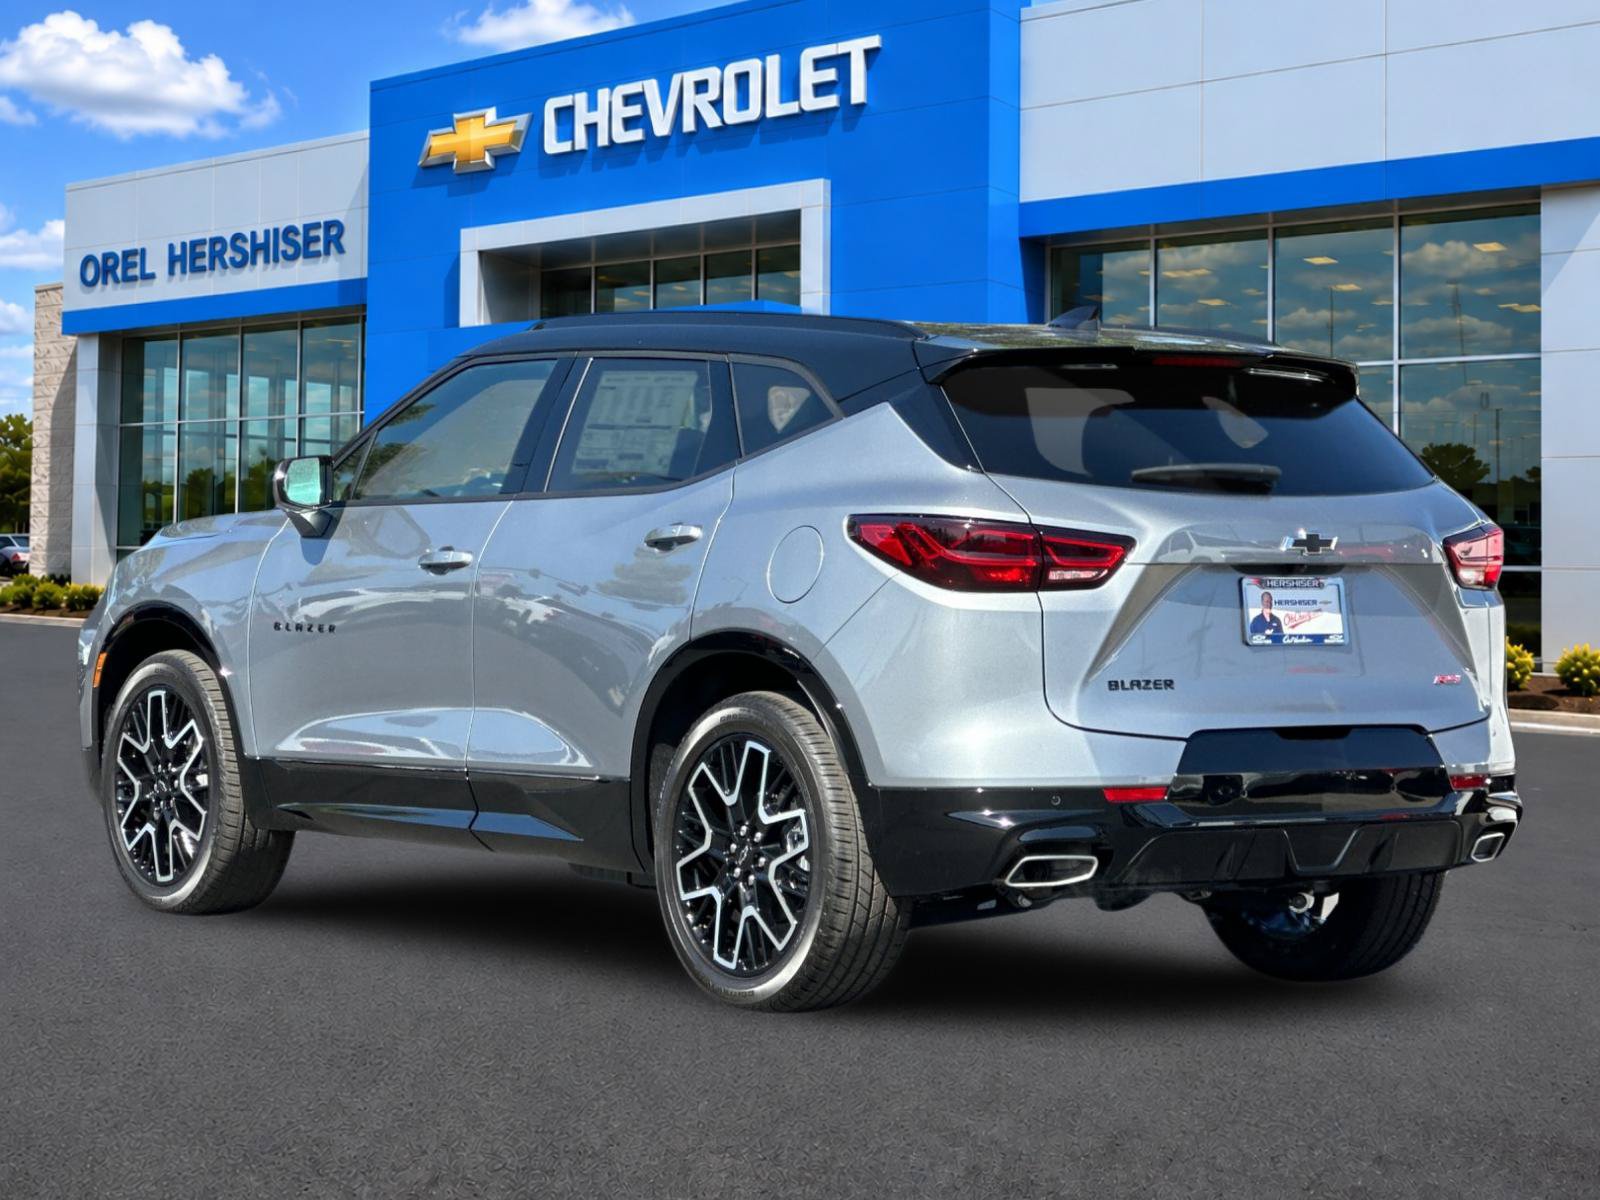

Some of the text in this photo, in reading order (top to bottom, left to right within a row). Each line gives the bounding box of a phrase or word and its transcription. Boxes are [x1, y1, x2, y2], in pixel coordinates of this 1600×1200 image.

[544, 34, 881, 154] CHEVROLET
[80, 219, 346, 287] OREL HERSHISER
[1266, 579, 1320, 588] HERSHISER
[273, 621, 336, 633] BLAZER
[1107, 679, 1175, 691] BLAZER
